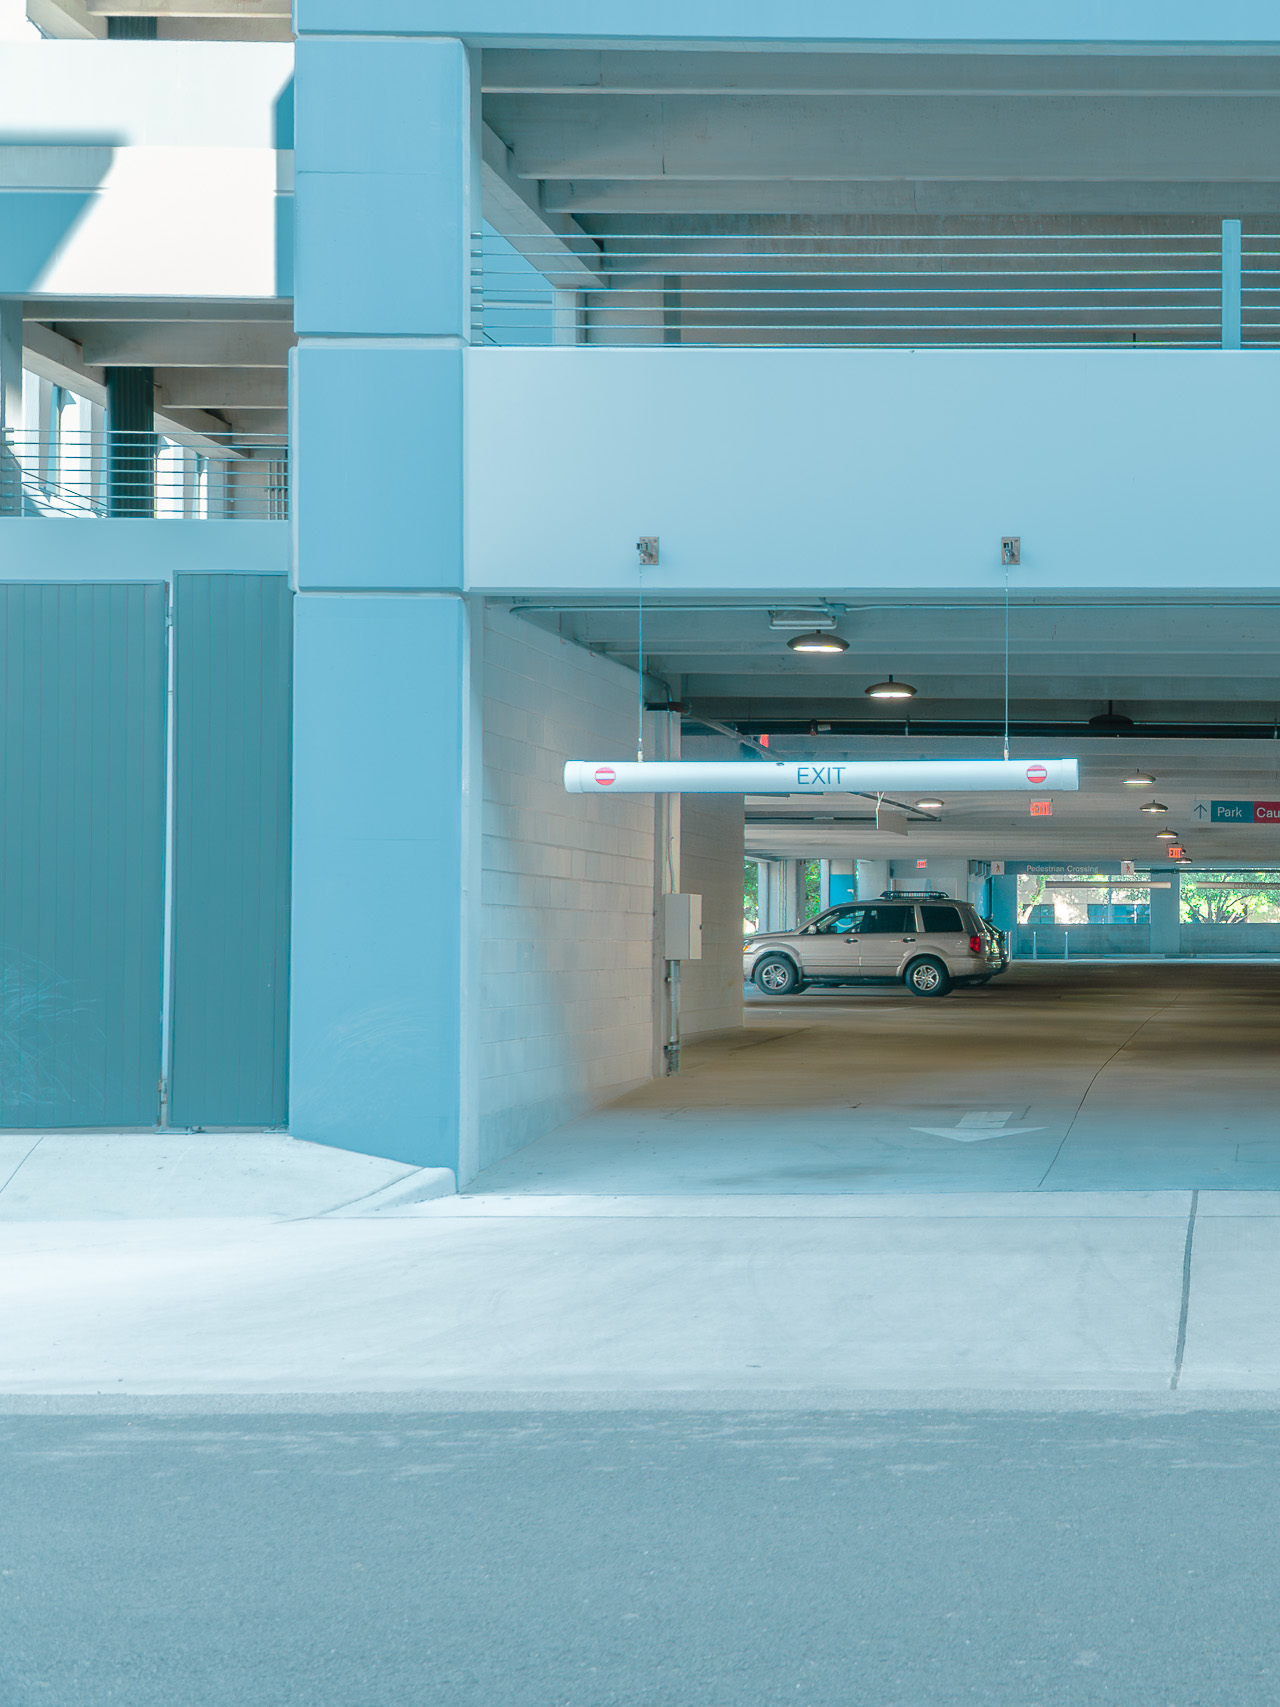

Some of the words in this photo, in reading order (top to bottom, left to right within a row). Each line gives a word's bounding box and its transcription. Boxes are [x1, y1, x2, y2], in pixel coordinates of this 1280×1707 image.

[797, 767, 845, 784] EXIT
[1217, 807, 1242, 818] Park
[1067, 865, 1099, 873] Crossing
